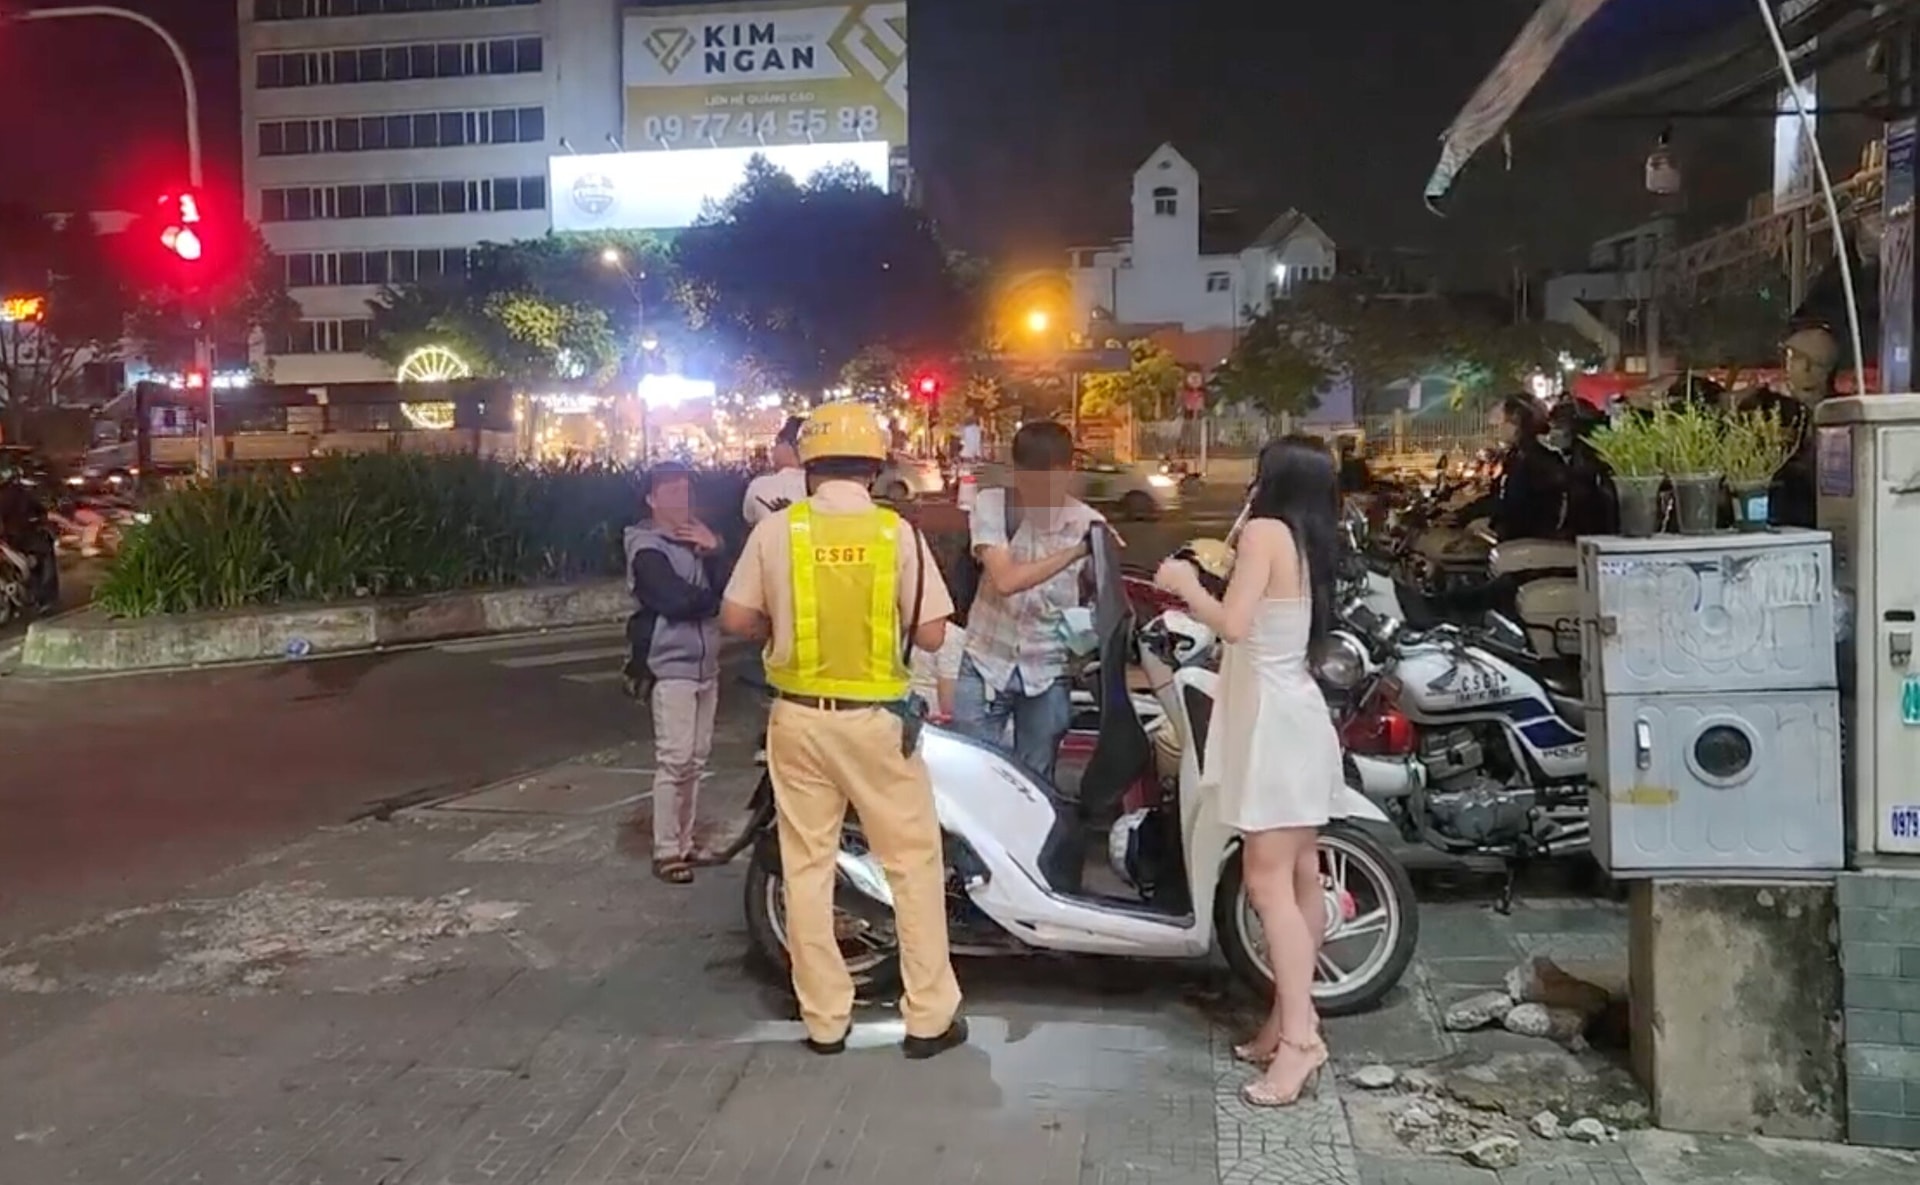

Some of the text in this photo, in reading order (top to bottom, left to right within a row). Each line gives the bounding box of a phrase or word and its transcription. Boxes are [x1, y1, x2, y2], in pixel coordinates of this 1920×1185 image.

[704, 22, 775, 48] KIM
[704, 46, 814, 73] NGAN
[644, 105, 879, 143] 09 77 44 55 88
[815, 547, 866, 563] CSGT
[1891, 811, 1919, 837] 0979
